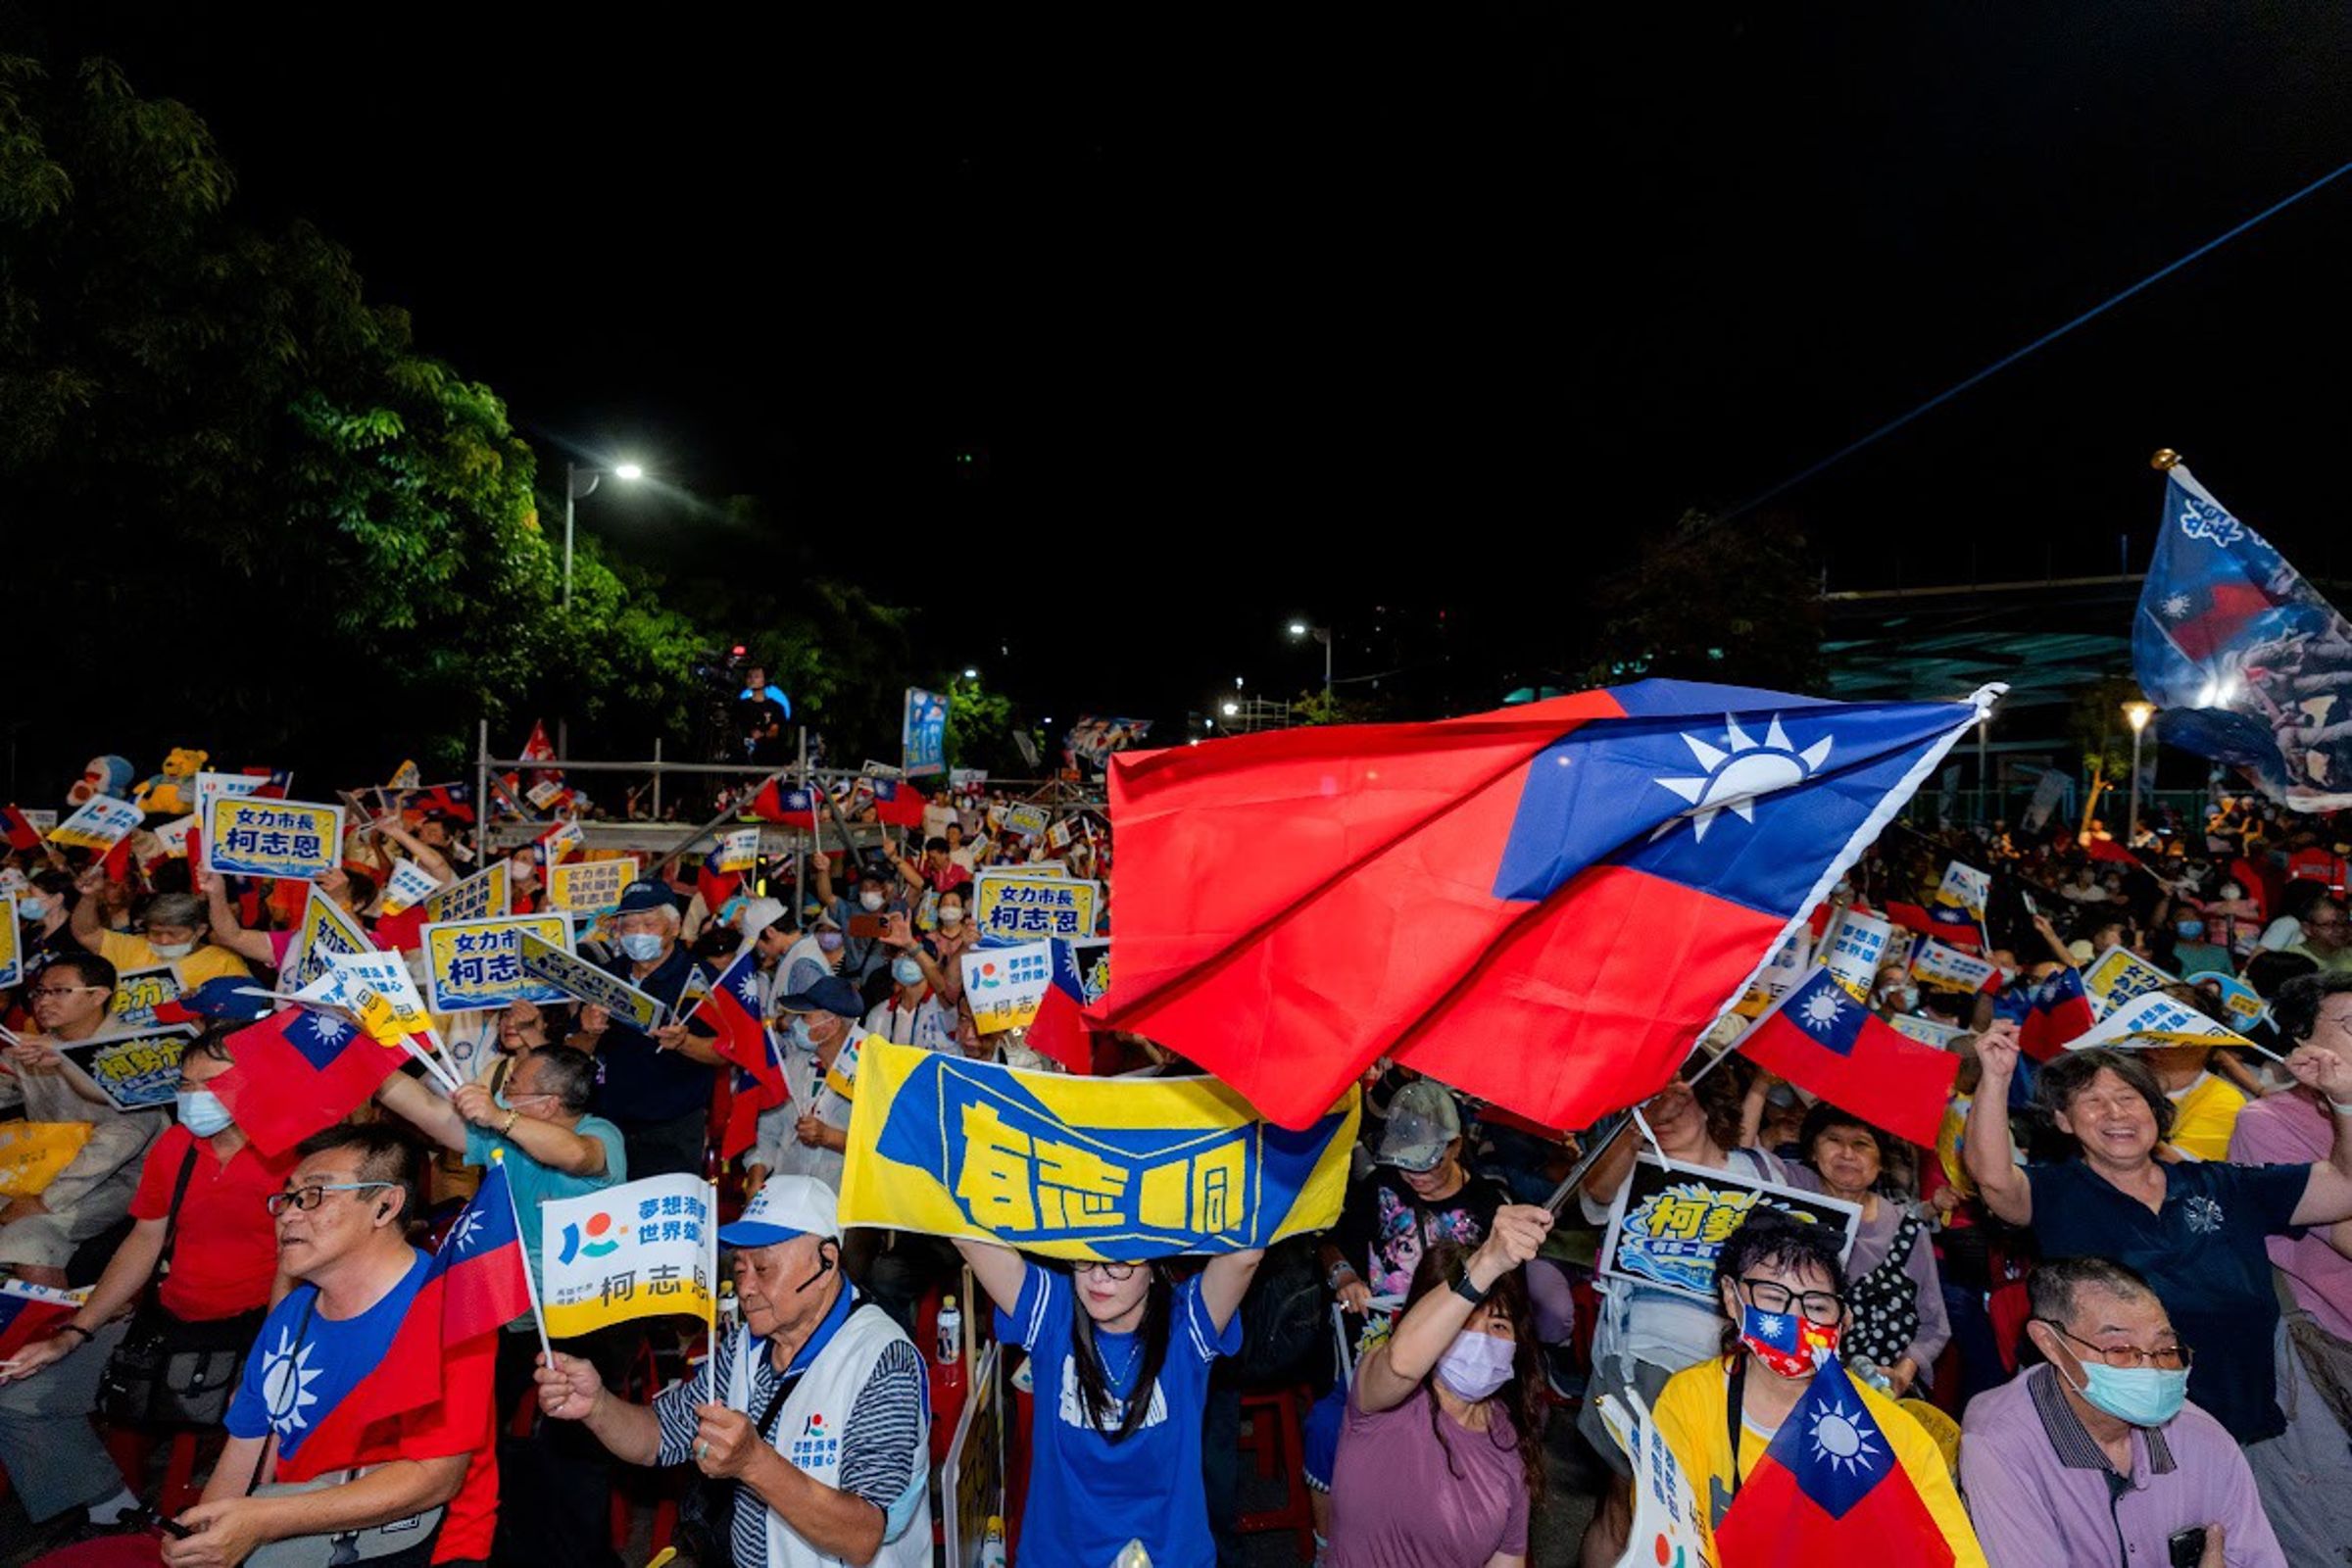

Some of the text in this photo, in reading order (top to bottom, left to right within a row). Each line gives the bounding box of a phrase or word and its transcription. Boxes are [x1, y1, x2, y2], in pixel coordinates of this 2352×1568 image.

[236, 808, 314, 831] 女力市長
[226, 827, 320, 859] 柯志恩
[1000, 885, 1075, 906] 女力市長
[990, 905, 1079, 933] 柯志恩
[318, 916, 356, 955] 女力市
